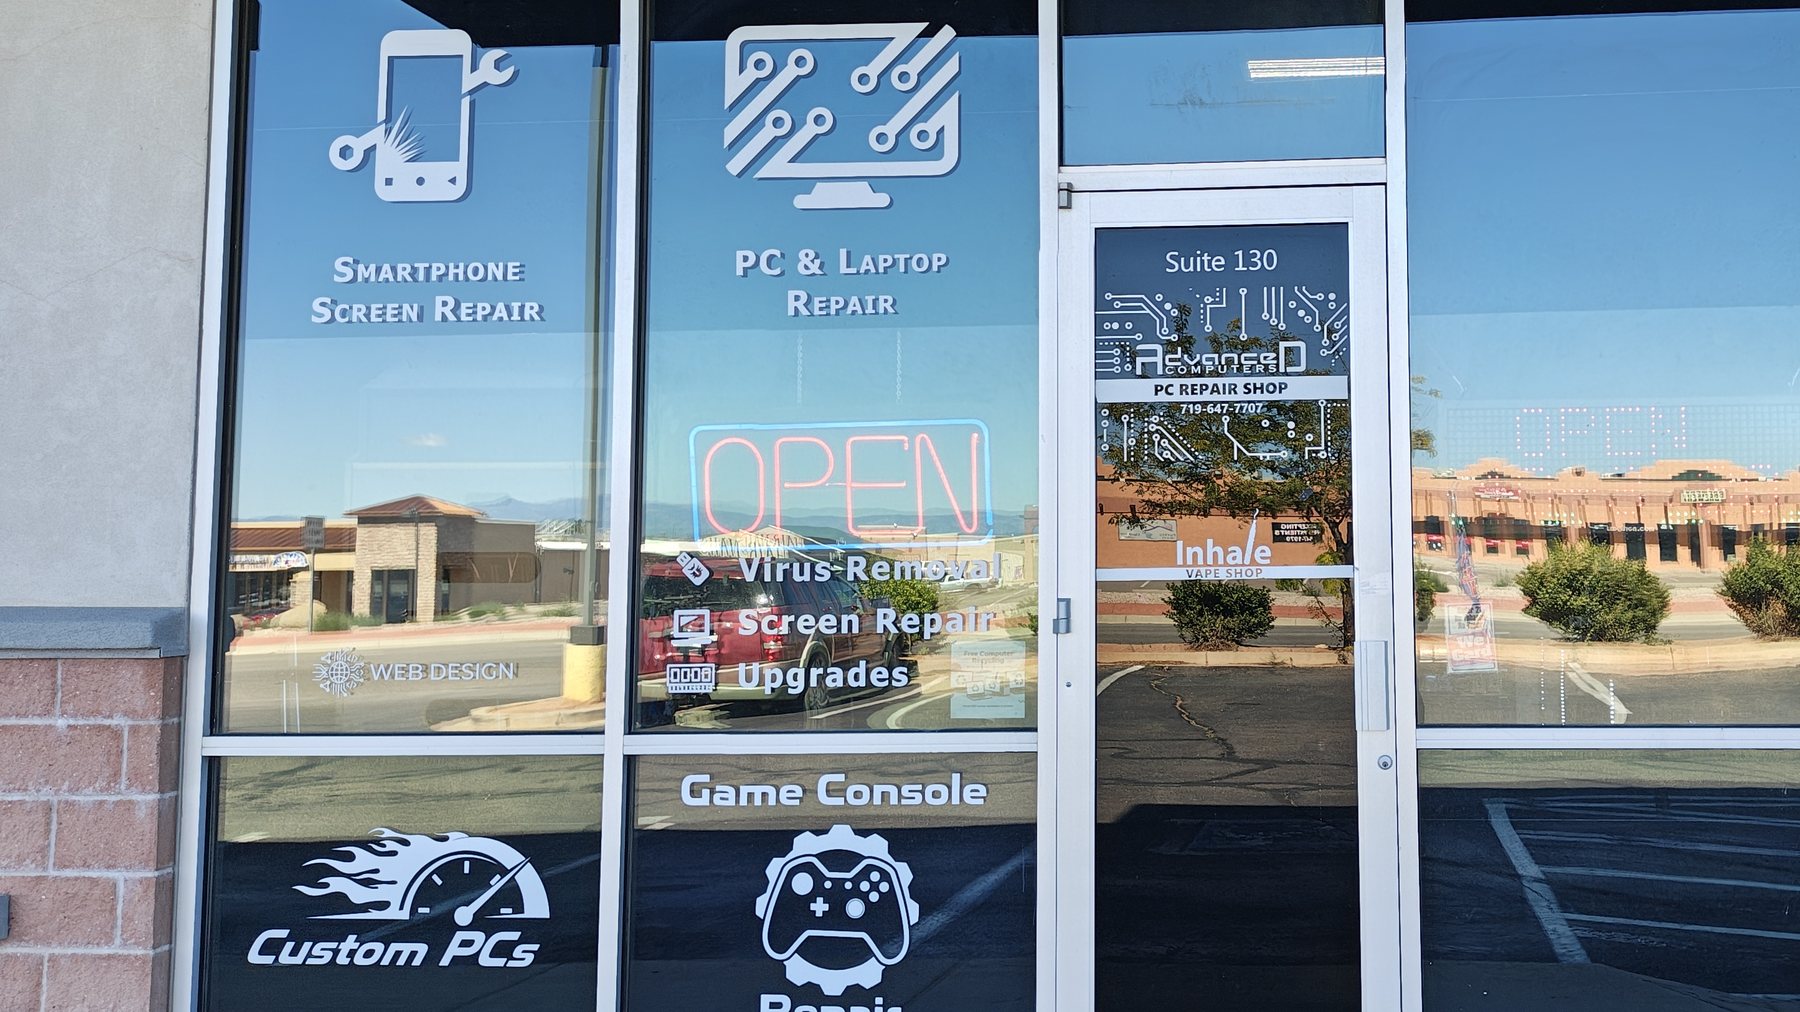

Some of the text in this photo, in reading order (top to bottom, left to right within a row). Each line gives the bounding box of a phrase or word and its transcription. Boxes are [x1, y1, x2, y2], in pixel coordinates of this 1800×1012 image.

[735, 248, 783, 277] PC
[797, 248, 825, 276] &
[1165, 249, 1278, 273] Suite 130
[1165, 364, 1278, 375] COMPUTERS
[1154, 381, 1289, 396] PC REPAIR SHOP
[1181, 402, 1264, 415] 719-647-7707
[1515, 406, 1687, 457] OPEN
[704, 432, 980, 537] OPEN
[1176, 514, 1273, 566] Inhale
[738, 552, 1003, 583] Virus Removal
[1186, 567, 1263, 579] VAPE SHOP
[738, 605, 997, 641] Screen Repair
[370, 661, 516, 681] WEB DESIGN
[738, 660, 911, 695] Upgrades
[680, 772, 988, 807] Game Console
[247, 929, 541, 967] Custom PCs
